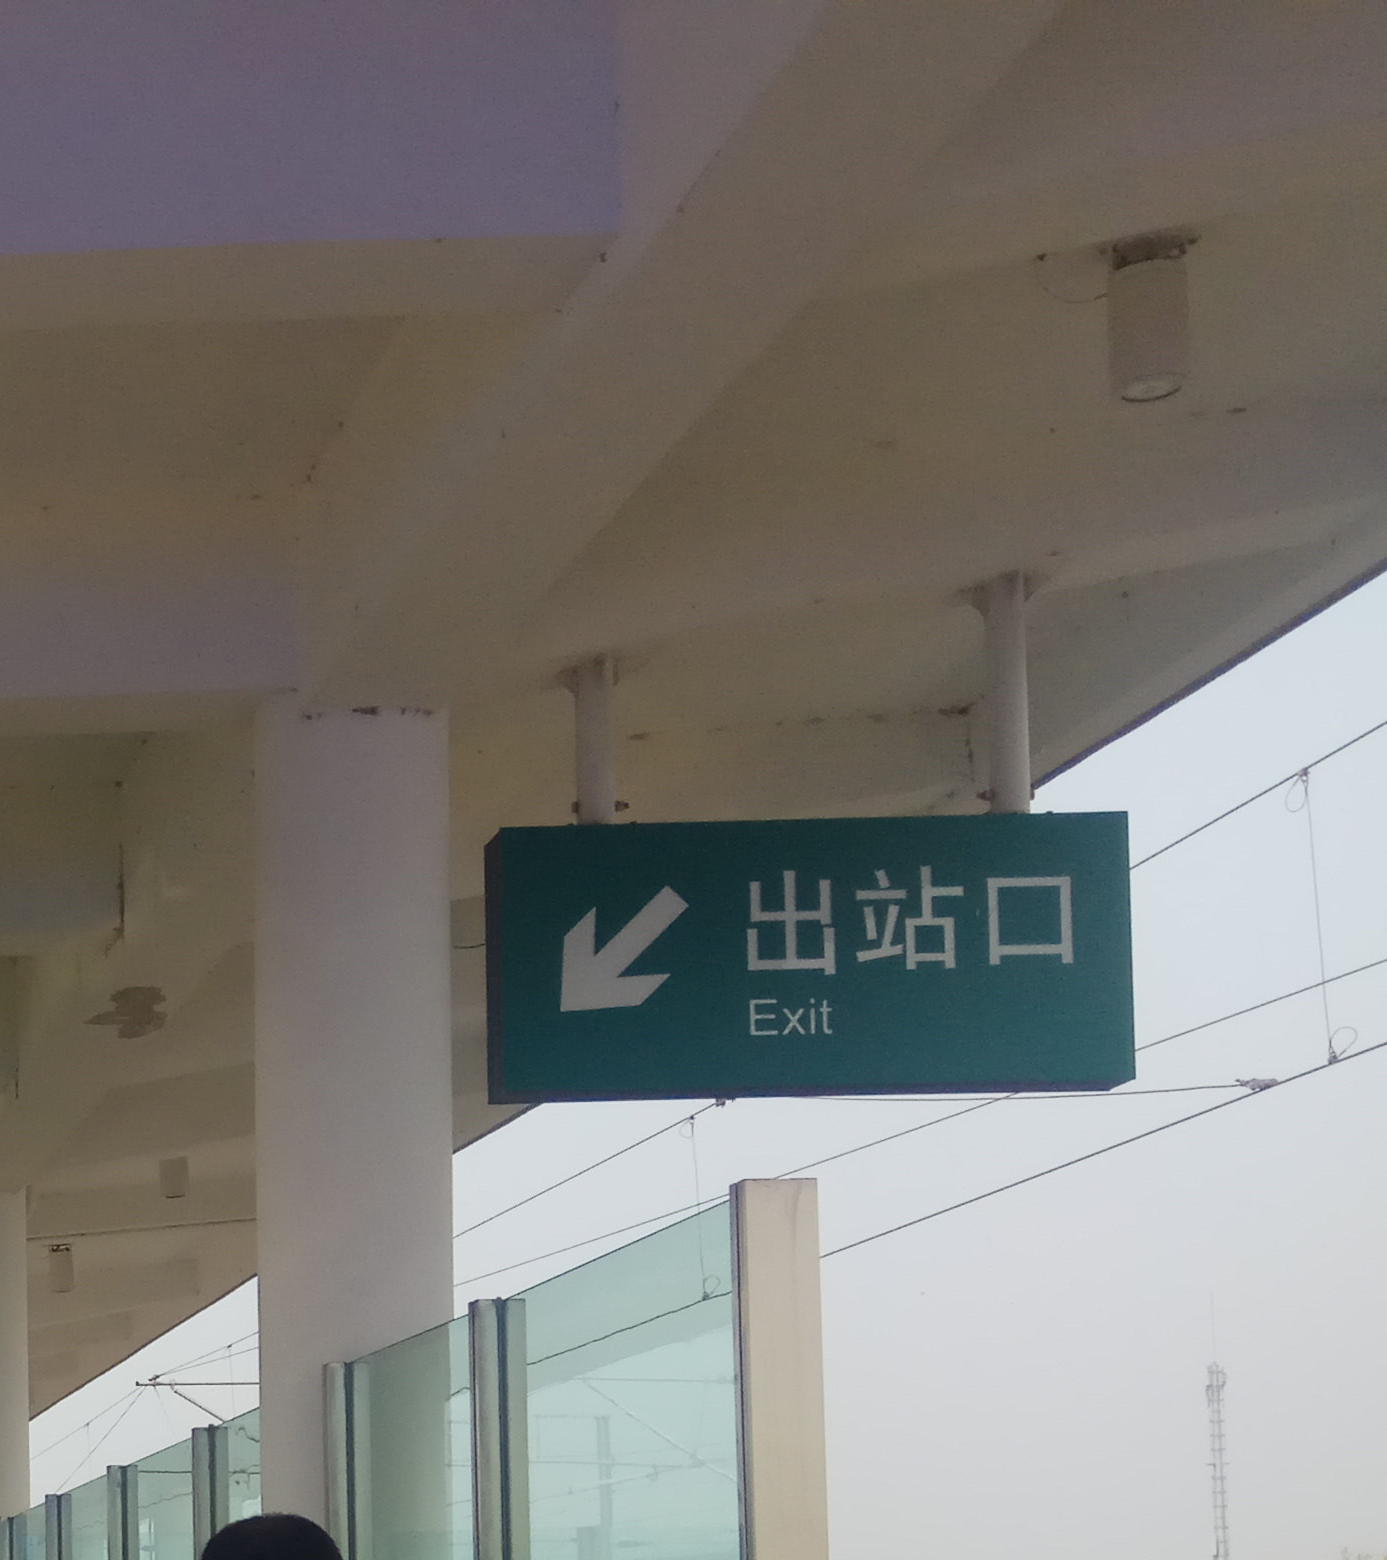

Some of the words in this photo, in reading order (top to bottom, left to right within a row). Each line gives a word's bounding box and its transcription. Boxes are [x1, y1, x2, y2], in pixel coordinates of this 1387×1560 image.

[746, 864, 1075, 976] 出站口
[748, 998, 834, 1037] Exit
